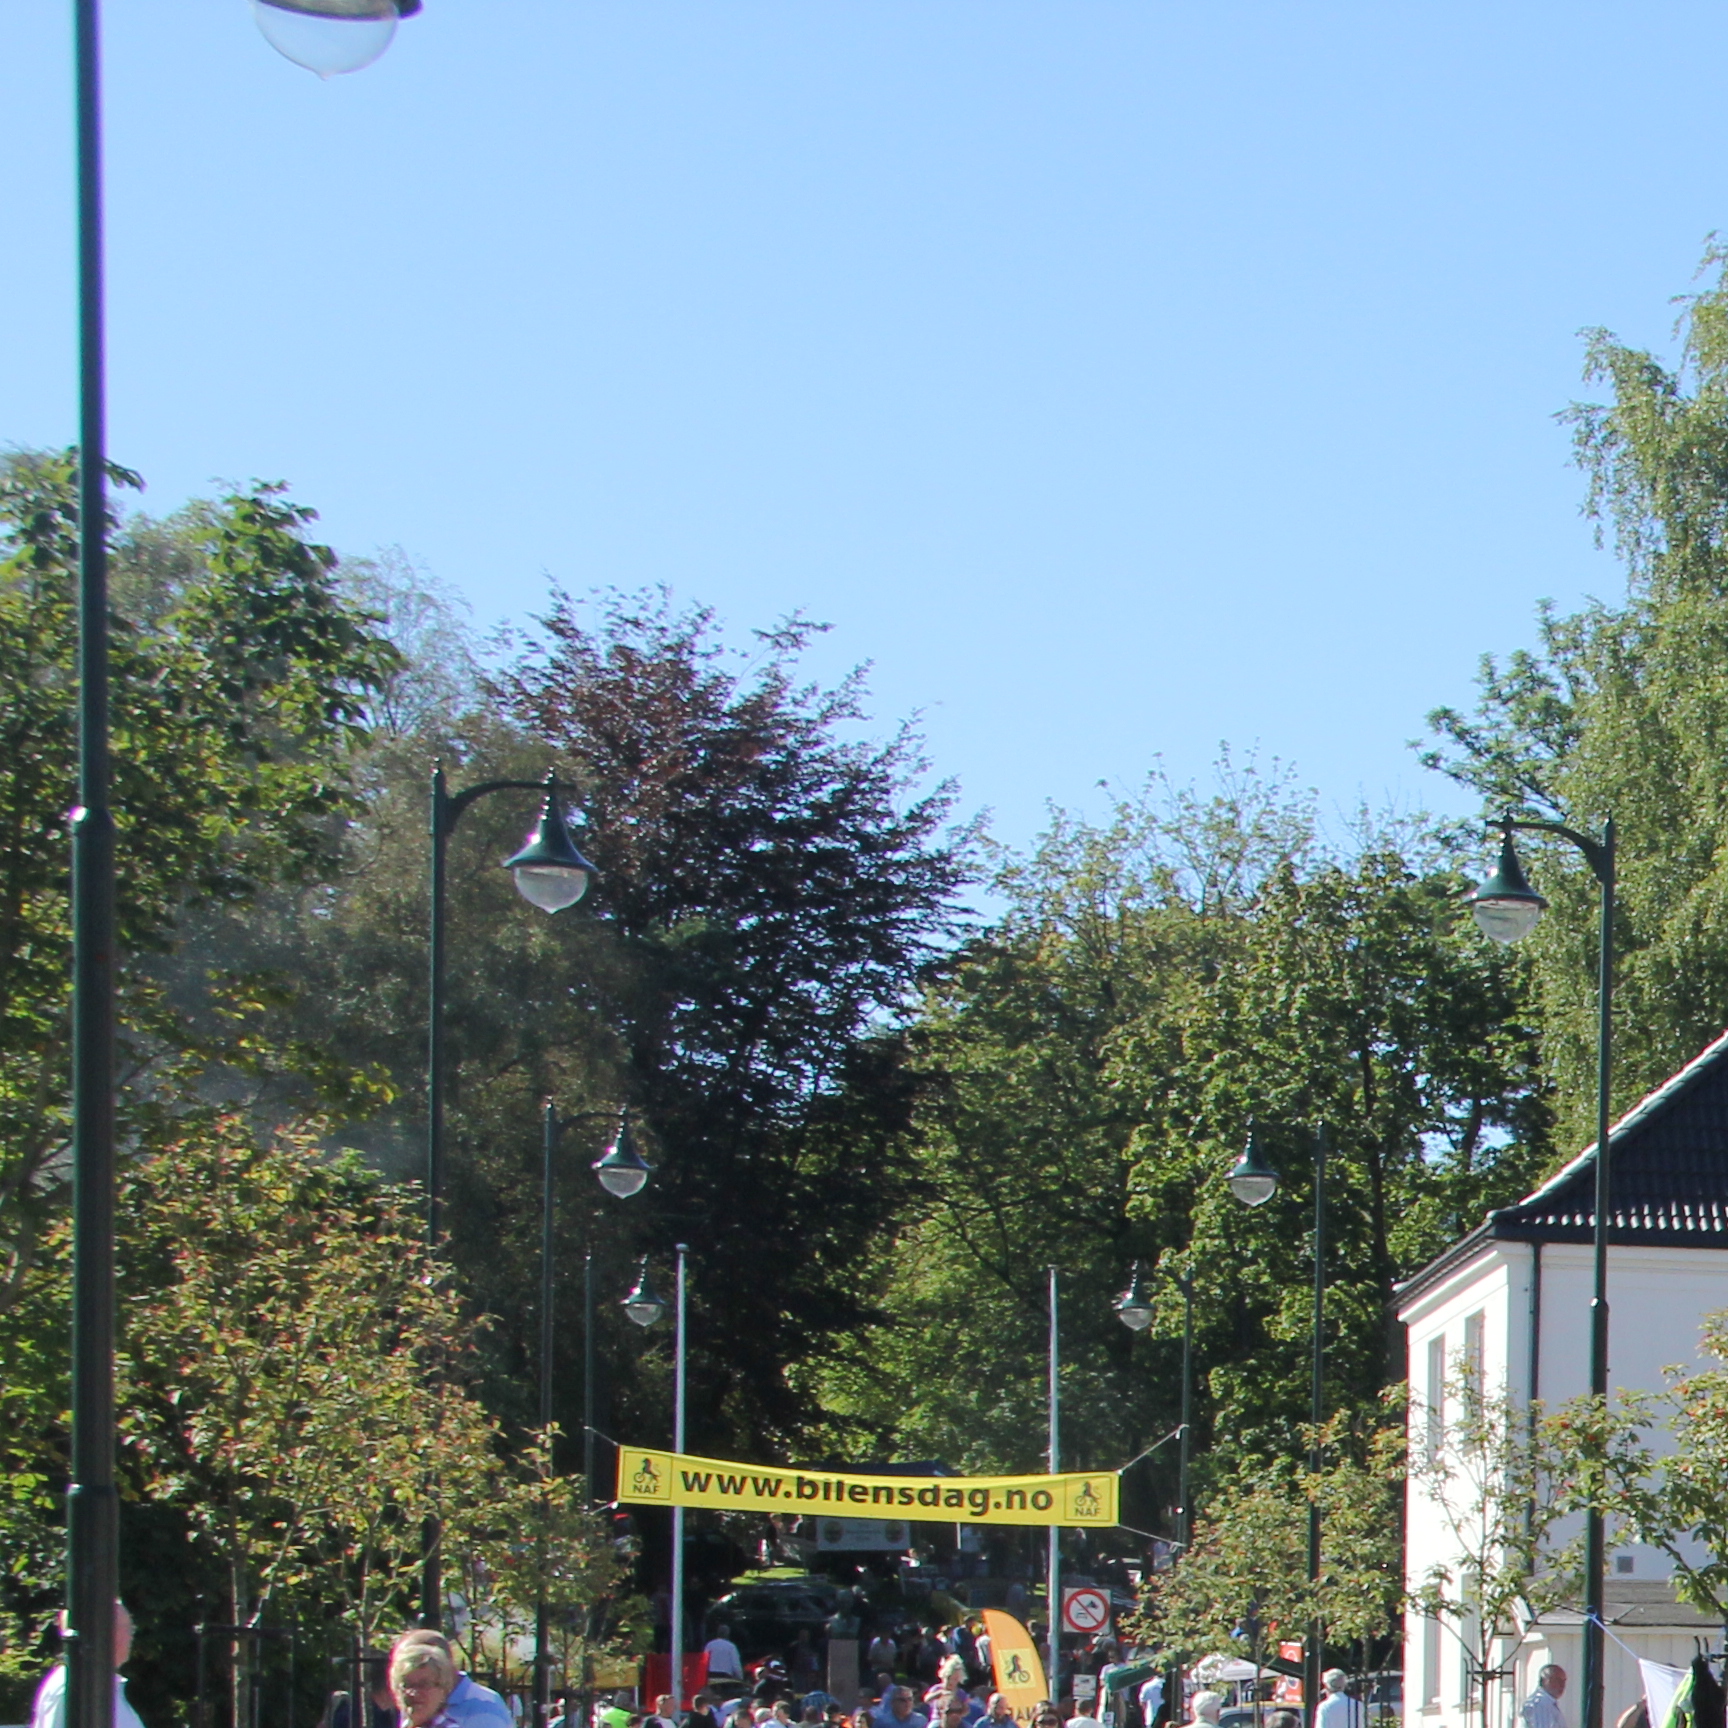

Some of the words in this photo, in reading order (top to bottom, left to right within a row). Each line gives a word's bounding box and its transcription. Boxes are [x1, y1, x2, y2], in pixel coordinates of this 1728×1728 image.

[633, 1484, 661, 1494] NAF
[681, 1470, 1054, 1516] www.bilensdag.no
[1074, 1507, 1102, 1517] NAF
